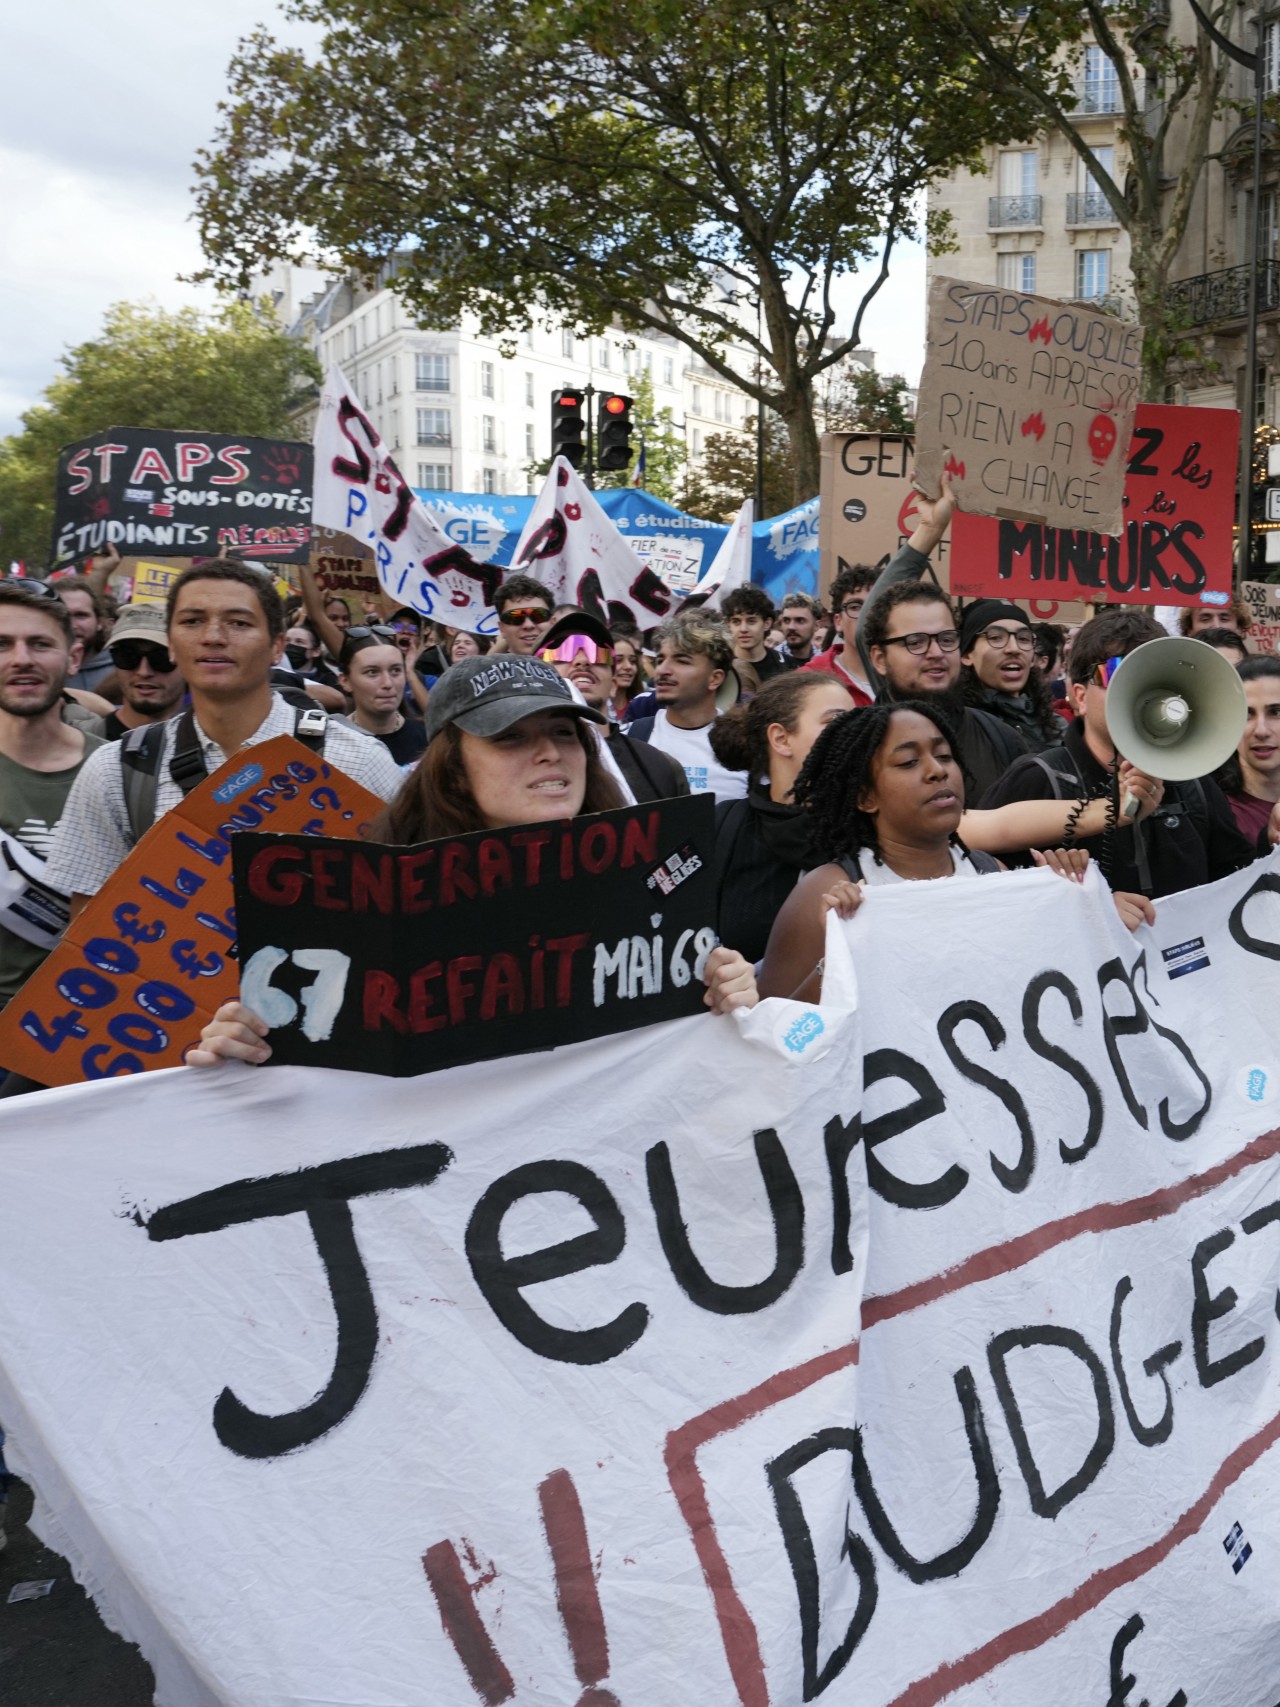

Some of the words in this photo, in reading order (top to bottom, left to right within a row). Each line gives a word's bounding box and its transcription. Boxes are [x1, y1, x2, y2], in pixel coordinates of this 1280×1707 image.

[944, 285, 1034, 336] STAPS
[1051, 421, 1075, 465] A
[66, 442, 252, 496] STAPS
[981, 458, 1101, 514] CHANGÉ
[1171, 441, 1213, 489] les
[1142, 491, 1177, 516] les
[631, 539, 656, 552] FIER
[470, 662, 515, 697] NEW
[218, 767, 264, 799] FAGE
[139, 867, 207, 909] la
[239, 944, 351, 1043] 67
[669, 925, 716, 990] 68
[786, 1013, 821, 1052] FAGE
